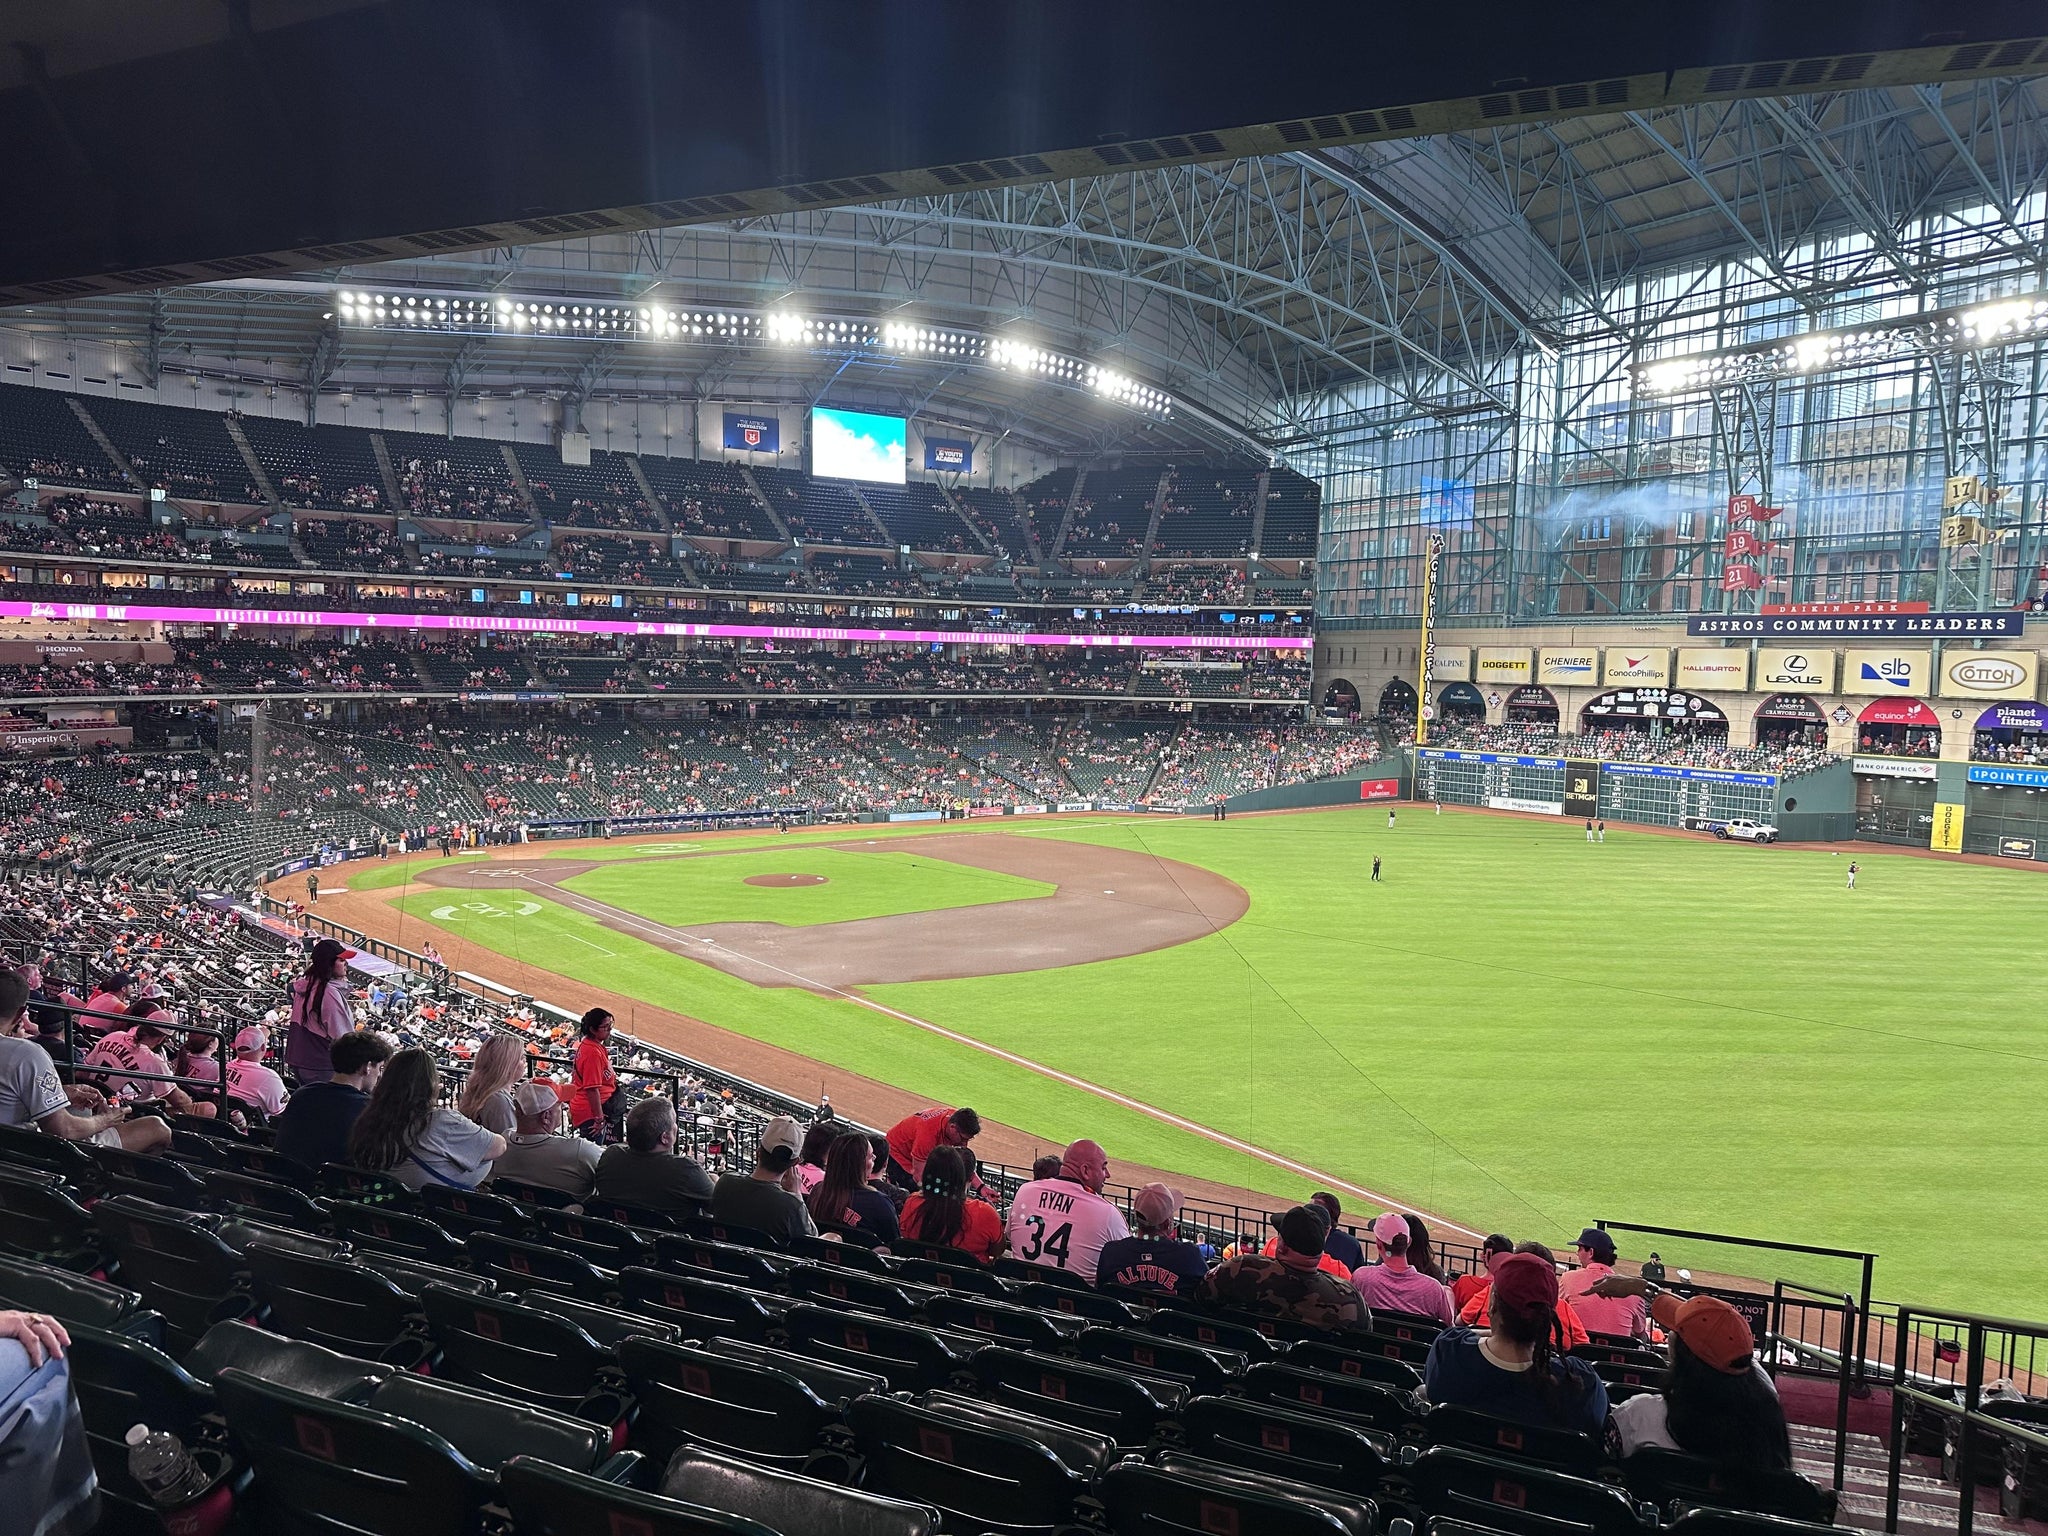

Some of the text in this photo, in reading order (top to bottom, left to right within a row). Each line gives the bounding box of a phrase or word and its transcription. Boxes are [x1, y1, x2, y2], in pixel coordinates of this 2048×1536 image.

[936, 455, 963, 464] ACADEMY
[1953, 482, 1970, 498] 17
[1733, 500, 1747, 514] 05
[1948, 524, 1966, 538] 22
[1732, 536, 1745, 550] 19
[1728, 570, 1742, 582] 21
[107, 607, 126, 619] DAY
[1142, 604, 1200, 612] Gallagher Club
[216, 610, 322, 624] HOUSTON ASTROS
[449, 617, 578, 630] CLEVELAND GUARDIANS
[1698, 618, 2007, 632] ASTROS COMMUNITY LEADERS
[1423, 560, 1438, 706] CHIKIN IZ FAIR
[1482, 662, 1527, 670] DOGGETT
[1544, 657, 1592, 666] CHENIERE
[1880, 658, 1911, 676] slb
[1608, 668, 1664, 679] ConocoPhillips
[1766, 674, 1822, 684] LEXUS
[1958, 666, 2015, 684] COTTON
[1874, 712, 1906, 720] equinor
[1996, 707, 2036, 718] planet
[2000, 716, 2043, 727] fitness
[18, 734, 58, 746] Insperity
[1566, 792, 1596, 802] BETMGM
[1512, 802, 1550, 811] Higginbotham
[1918, 814, 1934, 823] 36
[1944, 806, 1952, 846] DOGGETT
[461, 902, 514, 918] OXY
[98, 1040, 140, 1072] BREGMAN
[226, 1068, 243, 1086] EÑA
[1038, 1192, 1074, 1214] RYAN
[1022, 1214, 1073, 1268] 34
[1116, 1264, 1180, 1290] ALTUVE
[1744, 1306, 1766, 1315] NOT
